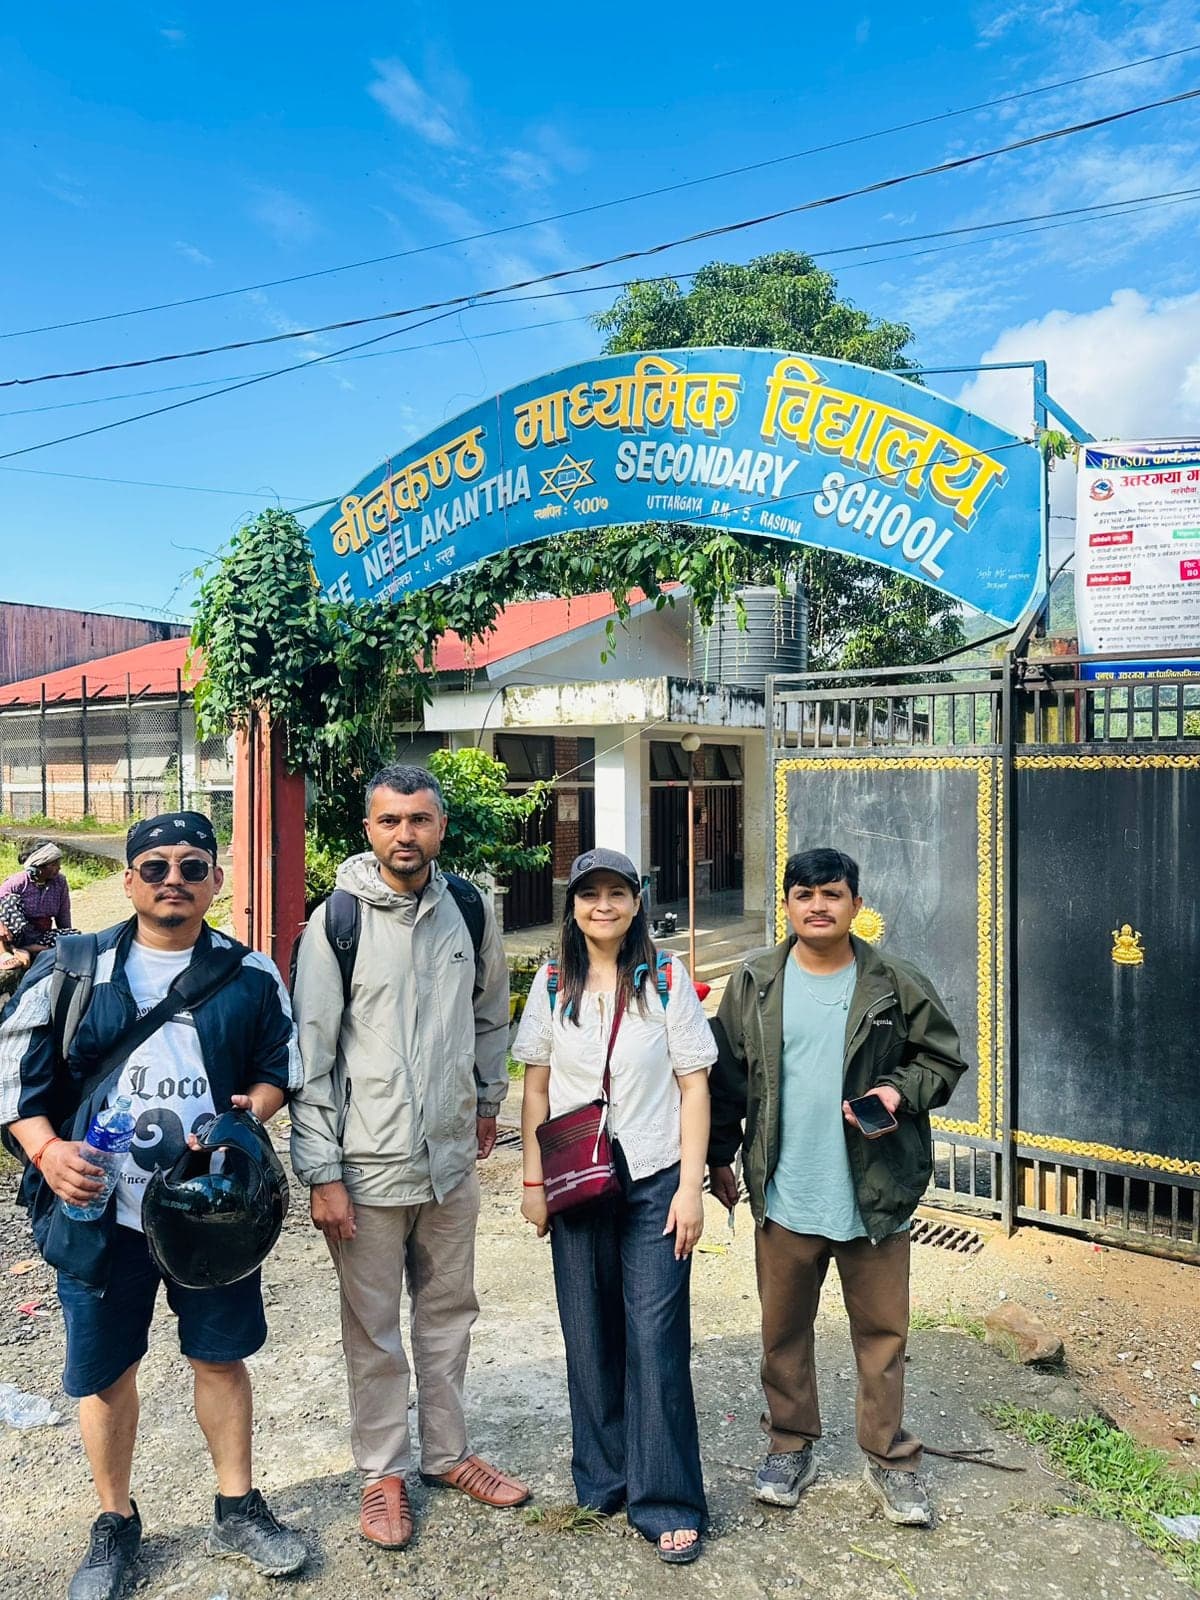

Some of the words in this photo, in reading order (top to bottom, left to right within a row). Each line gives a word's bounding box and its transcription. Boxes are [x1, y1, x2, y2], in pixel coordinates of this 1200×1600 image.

[330, 425, 487, 557] नीलकण्ठ
[514, 356, 743, 449] माध्यमिक
[760, 357, 1008, 524] विद्यालय
[1101, 455, 1150, 470] BTCSOL
[1120, 470, 1182, 487] उत्तरगया
[362, 464, 531, 588] NEELAKANTHA
[615, 441, 799, 500] SECONDARY
[813, 472, 954, 580] SCHOOL
[573, 496, 609, 516] २००७
[647, 495, 703, 513] UTTARGAYA
[760, 511, 803, 537] RASUWA
[128, 1064, 207, 1101] Loco
